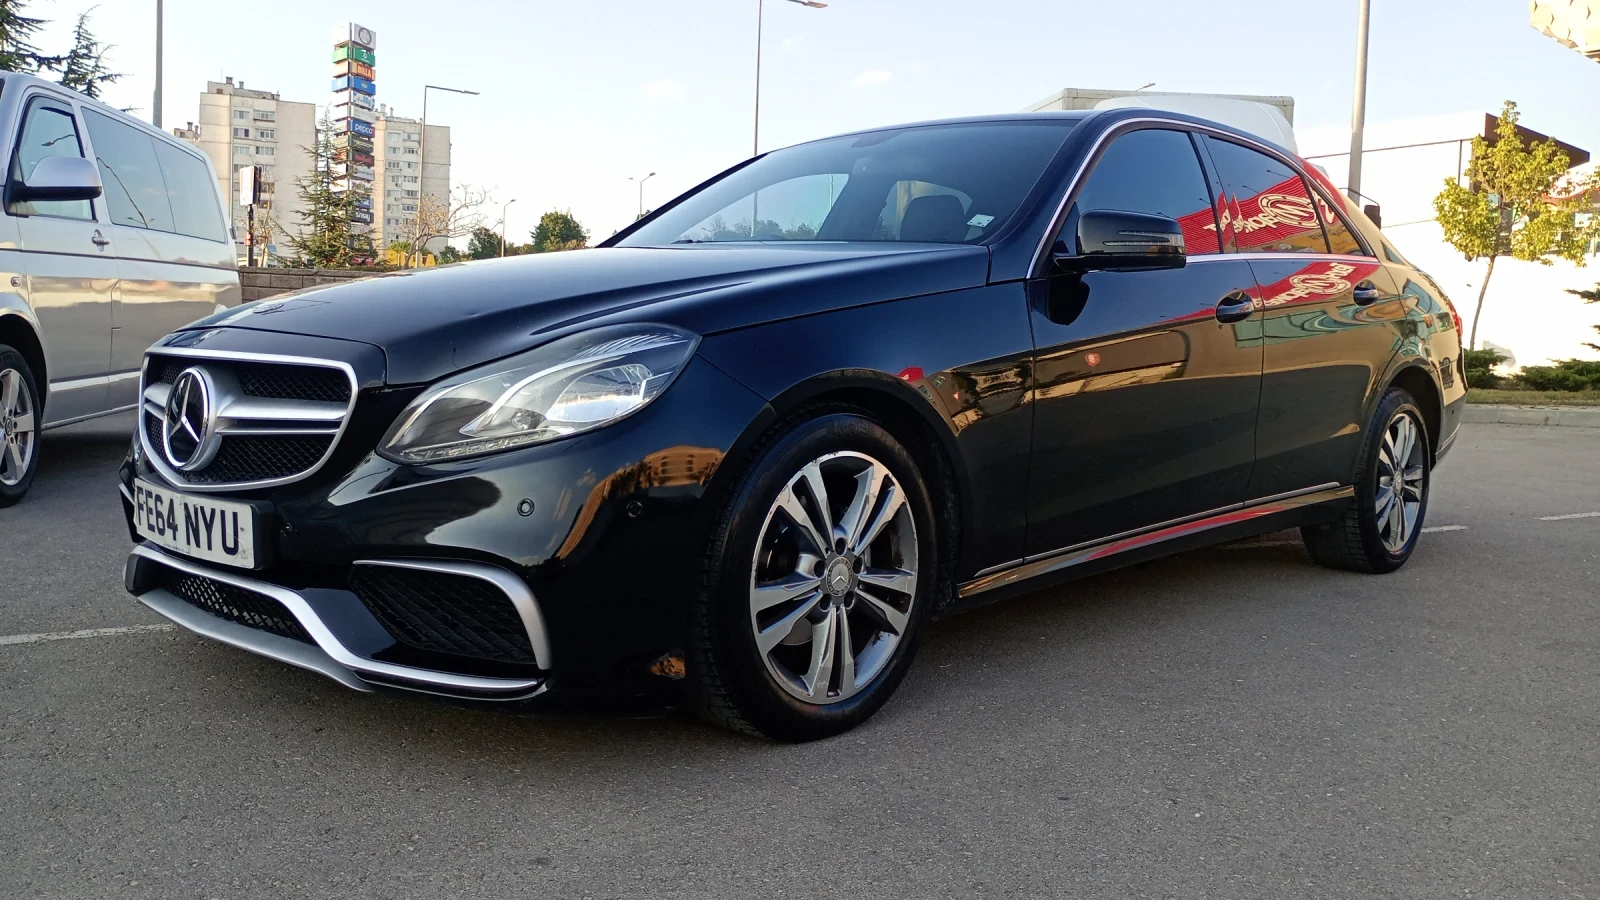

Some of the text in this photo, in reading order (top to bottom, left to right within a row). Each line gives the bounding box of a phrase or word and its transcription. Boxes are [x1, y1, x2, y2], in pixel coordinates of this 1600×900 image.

[354, 123, 373, 135] pepco
[136, 486, 239, 556] FE64 NYU
